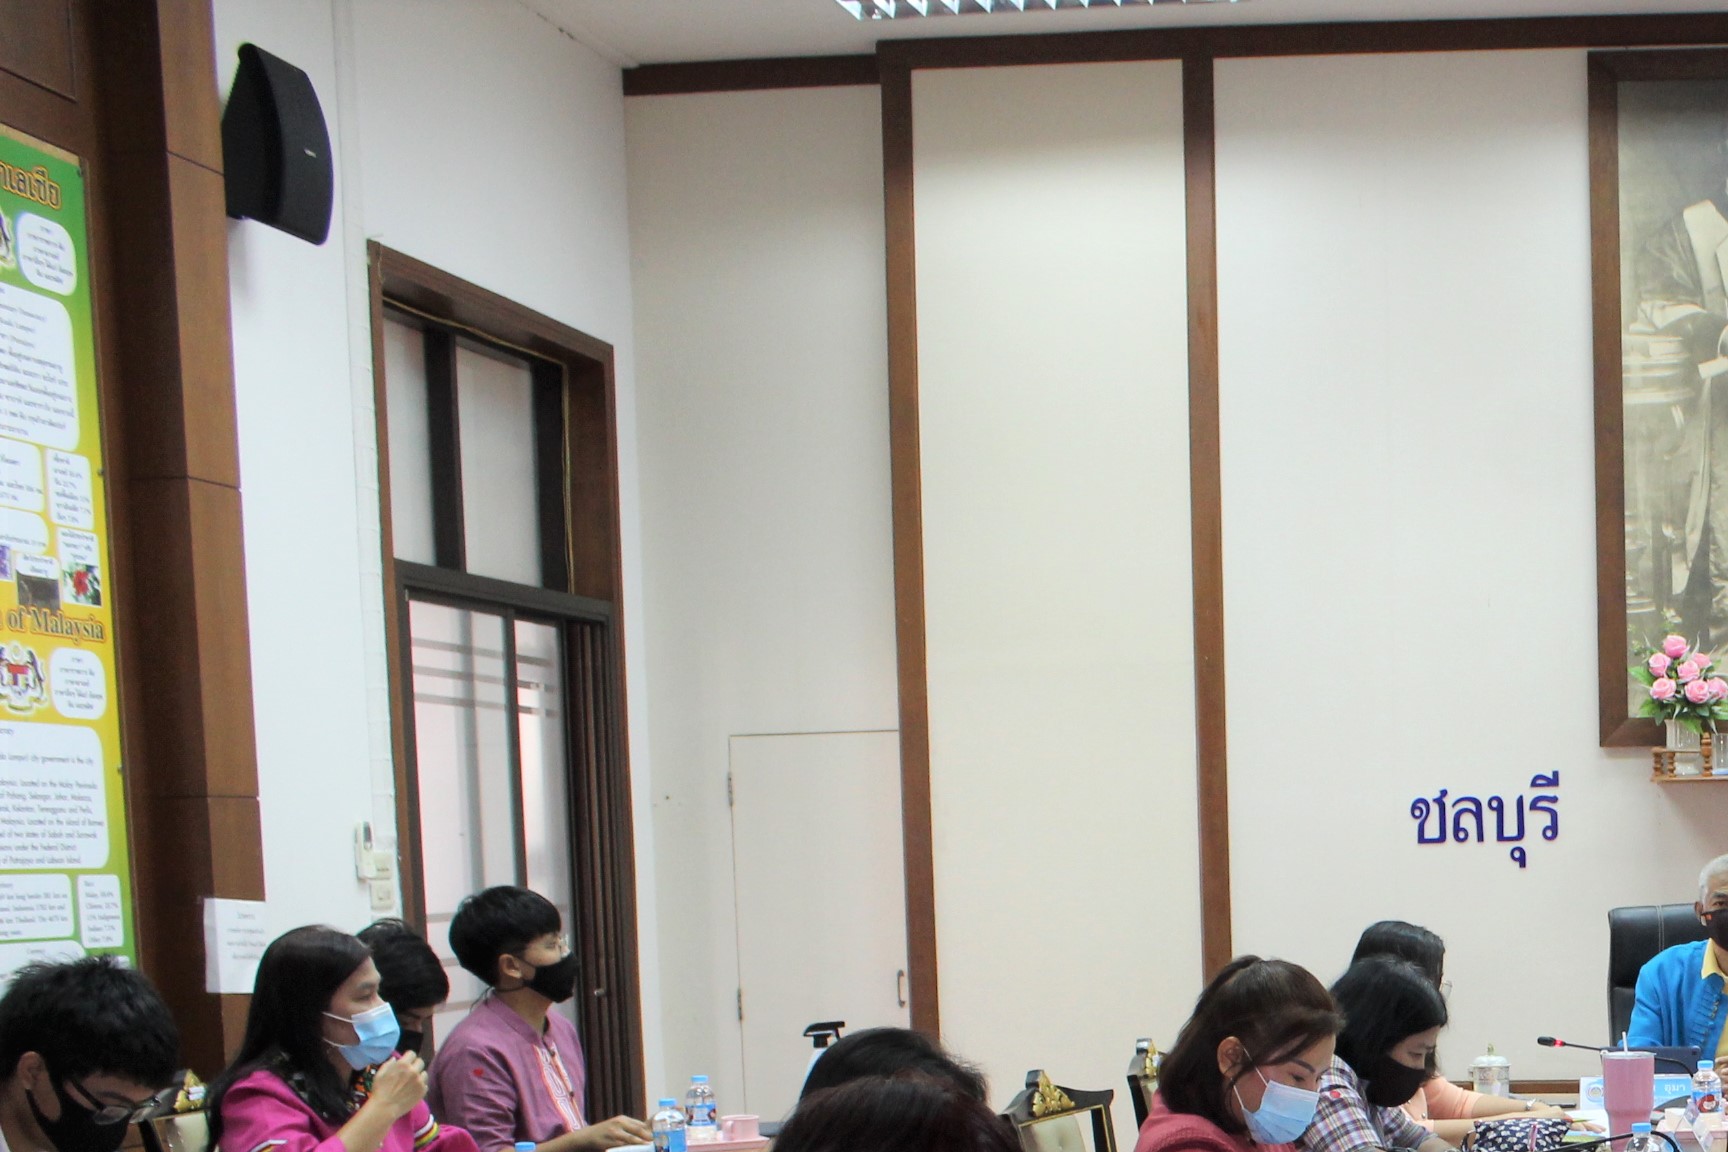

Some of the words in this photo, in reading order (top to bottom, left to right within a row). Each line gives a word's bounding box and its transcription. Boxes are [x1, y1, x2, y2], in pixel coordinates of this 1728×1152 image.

[7, 604, 27, 632] of
[29, 606, 106, 645] Malaysia
[1410, 770, 1560, 869] ชลบุรี
